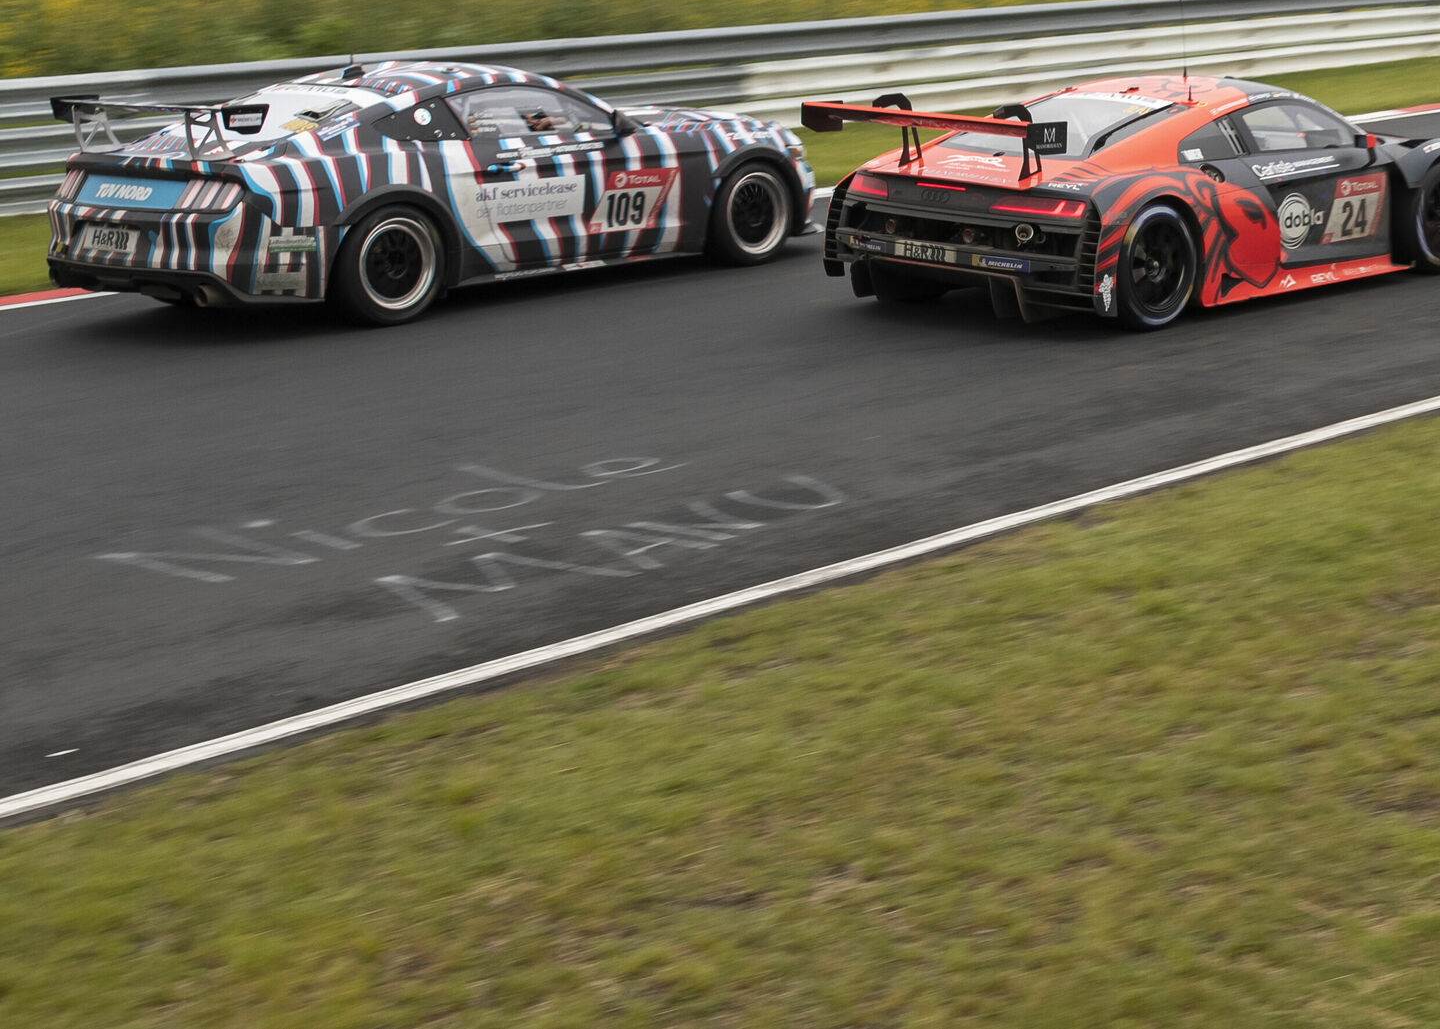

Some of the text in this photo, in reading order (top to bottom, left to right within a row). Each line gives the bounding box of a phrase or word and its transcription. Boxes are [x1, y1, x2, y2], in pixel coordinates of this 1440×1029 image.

[628, 174, 662, 184] TOTAL
[1048, 182, 1080, 191] REYL
[1352, 181, 1379, 191] TOTAL
[95, 183, 153, 201] TÜV NORD
[500, 183, 578, 199] servicelease
[606, 191, 646, 228] 109
[1341, 198, 1368, 236] 24
[1284, 208, 1325, 229] dobla
[987, 260, 1024, 269] MICHELIN
